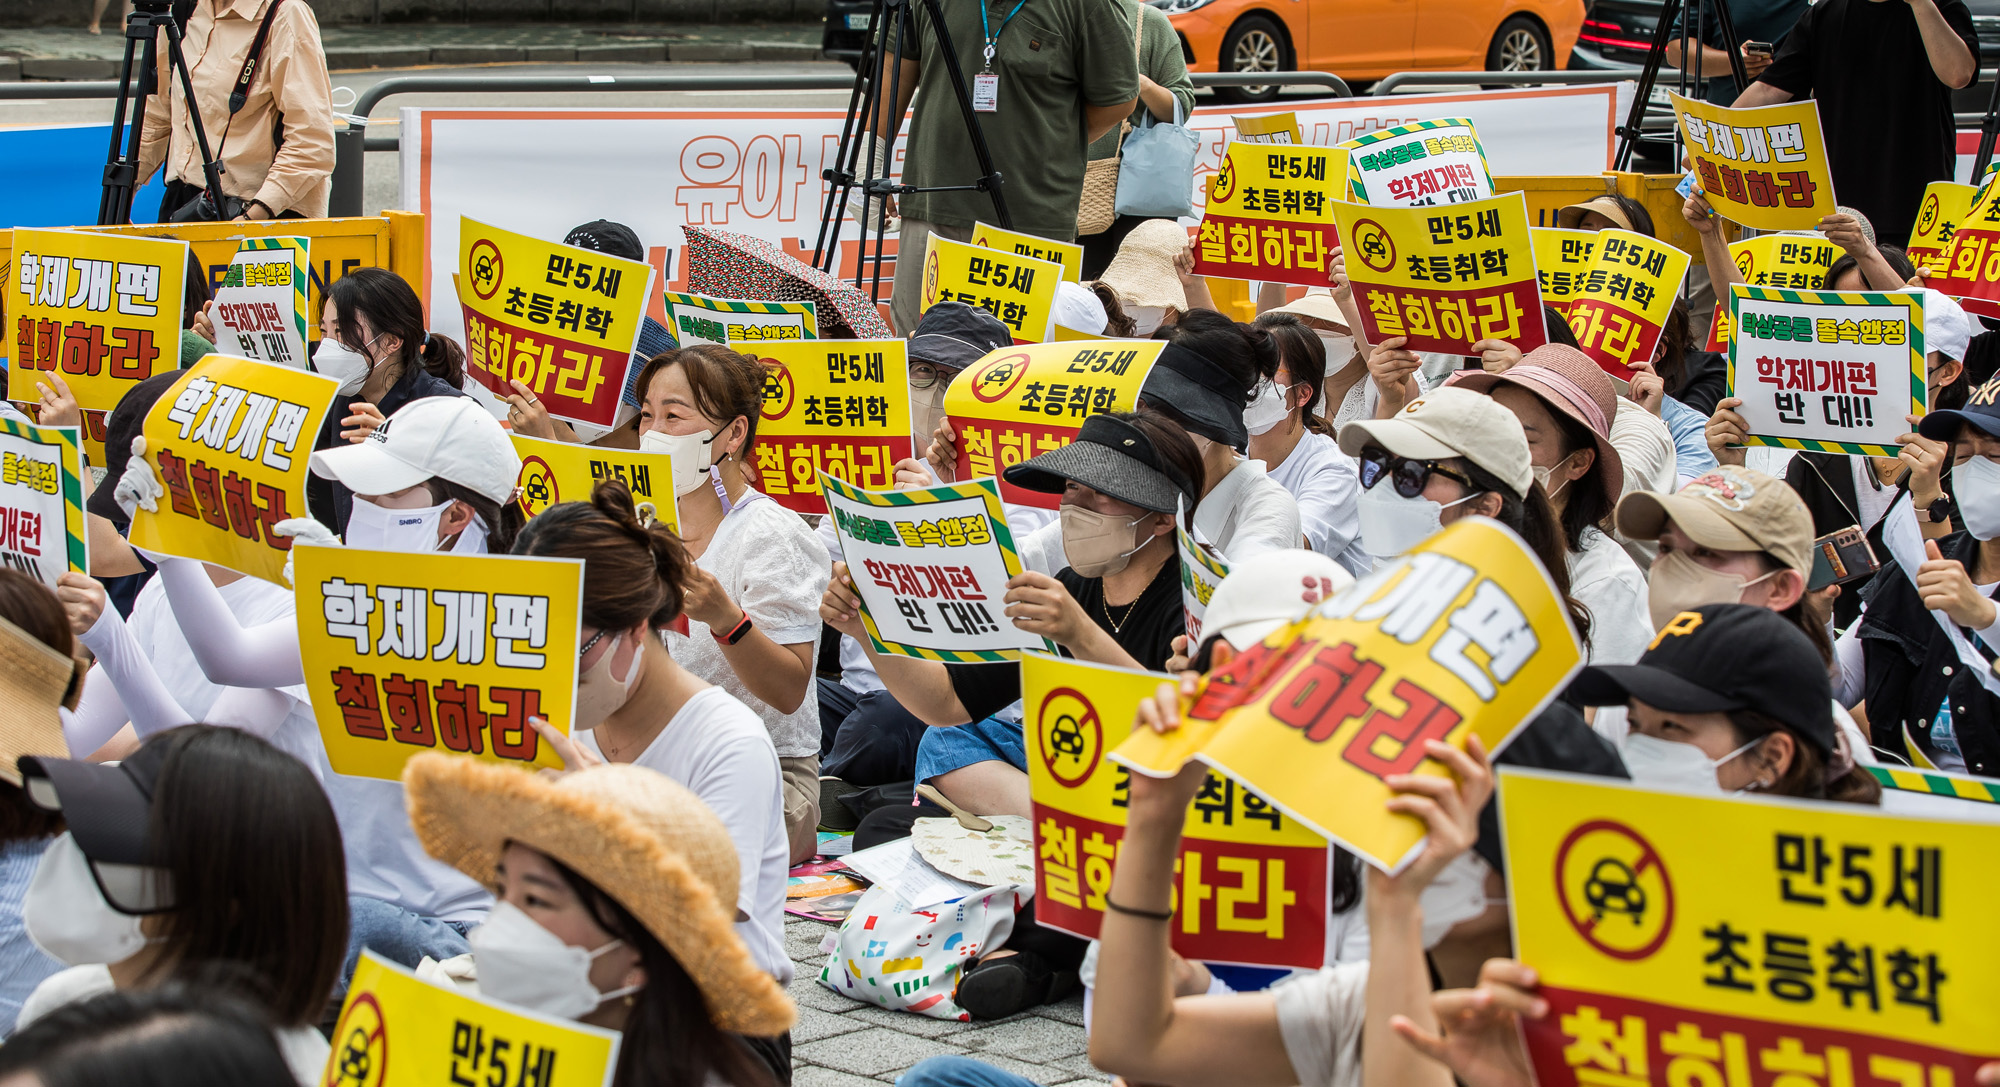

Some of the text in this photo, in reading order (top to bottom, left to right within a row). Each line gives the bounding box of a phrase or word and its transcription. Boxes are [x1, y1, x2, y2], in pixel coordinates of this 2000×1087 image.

[240, 58, 256, 84] EOS
[1360, 135, 1476, 172] 탁상공론 졸속행정
[1682, 112, 1807, 163] 학제개편
[675, 134, 807, 225] 유아
[1267, 154, 1327, 181] 만5세
[1387, 164, 1477, 200] 학제개편
[1696, 156, 1817, 208] 철회하라
[1243, 187, 1325, 217] 초등취학
[1199, 219, 1328, 273] 철회하라
[1427, 208, 1502, 245] 만5세
[245, 262, 291, 287] 졸속행정
[1406, 248, 1509, 283] 초등취학
[1602, 238, 1668, 279] 만5세
[1779, 242, 1834, 267] 만5세
[20, 251, 161, 317] 학제개편
[546, 253, 623, 299] 만5세
[968, 257, 1036, 294] 만5세
[1583, 270, 1656, 311] 등취학
[218, 302, 286, 333] 학제개편
[504, 286, 614, 340] 초등취학
[679, 315, 727, 344] 탁상공론
[1366, 289, 1524, 343] 철회하라
[1742, 312, 1813, 342] 탁상공론
[1816, 318, 1907, 345] 졸속행정
[17, 314, 160, 380] 철회하라
[261, 333, 292, 363] 대!!
[469, 315, 606, 405] 철회하라
[1066, 349, 1139, 376] 만5세
[827, 352, 885, 384] 만5세
[1756, 355, 1878, 396] 학제개편
[803, 395, 889, 427] 초등취학
[1019, 381, 1117, 418] 초등취학
[1774, 392, 1874, 428] 반 대!!
[167, 376, 310, 472] 학제개편
[157, 448, 295, 551] 철회하라
[894, 513, 991, 548] 졸속행정
[863, 558, 988, 600] 학제개편
[321, 576, 550, 670] 학제개편
[895, 598, 999, 635] 반 대!!
[1648, 611, 1704, 651] P
[331, 666, 549, 762] 철회하라
[1775, 832, 1943, 920] 만5세
[1700, 922, 1949, 1025] 초등취학
[449, 1018, 557, 1087] 만5세
